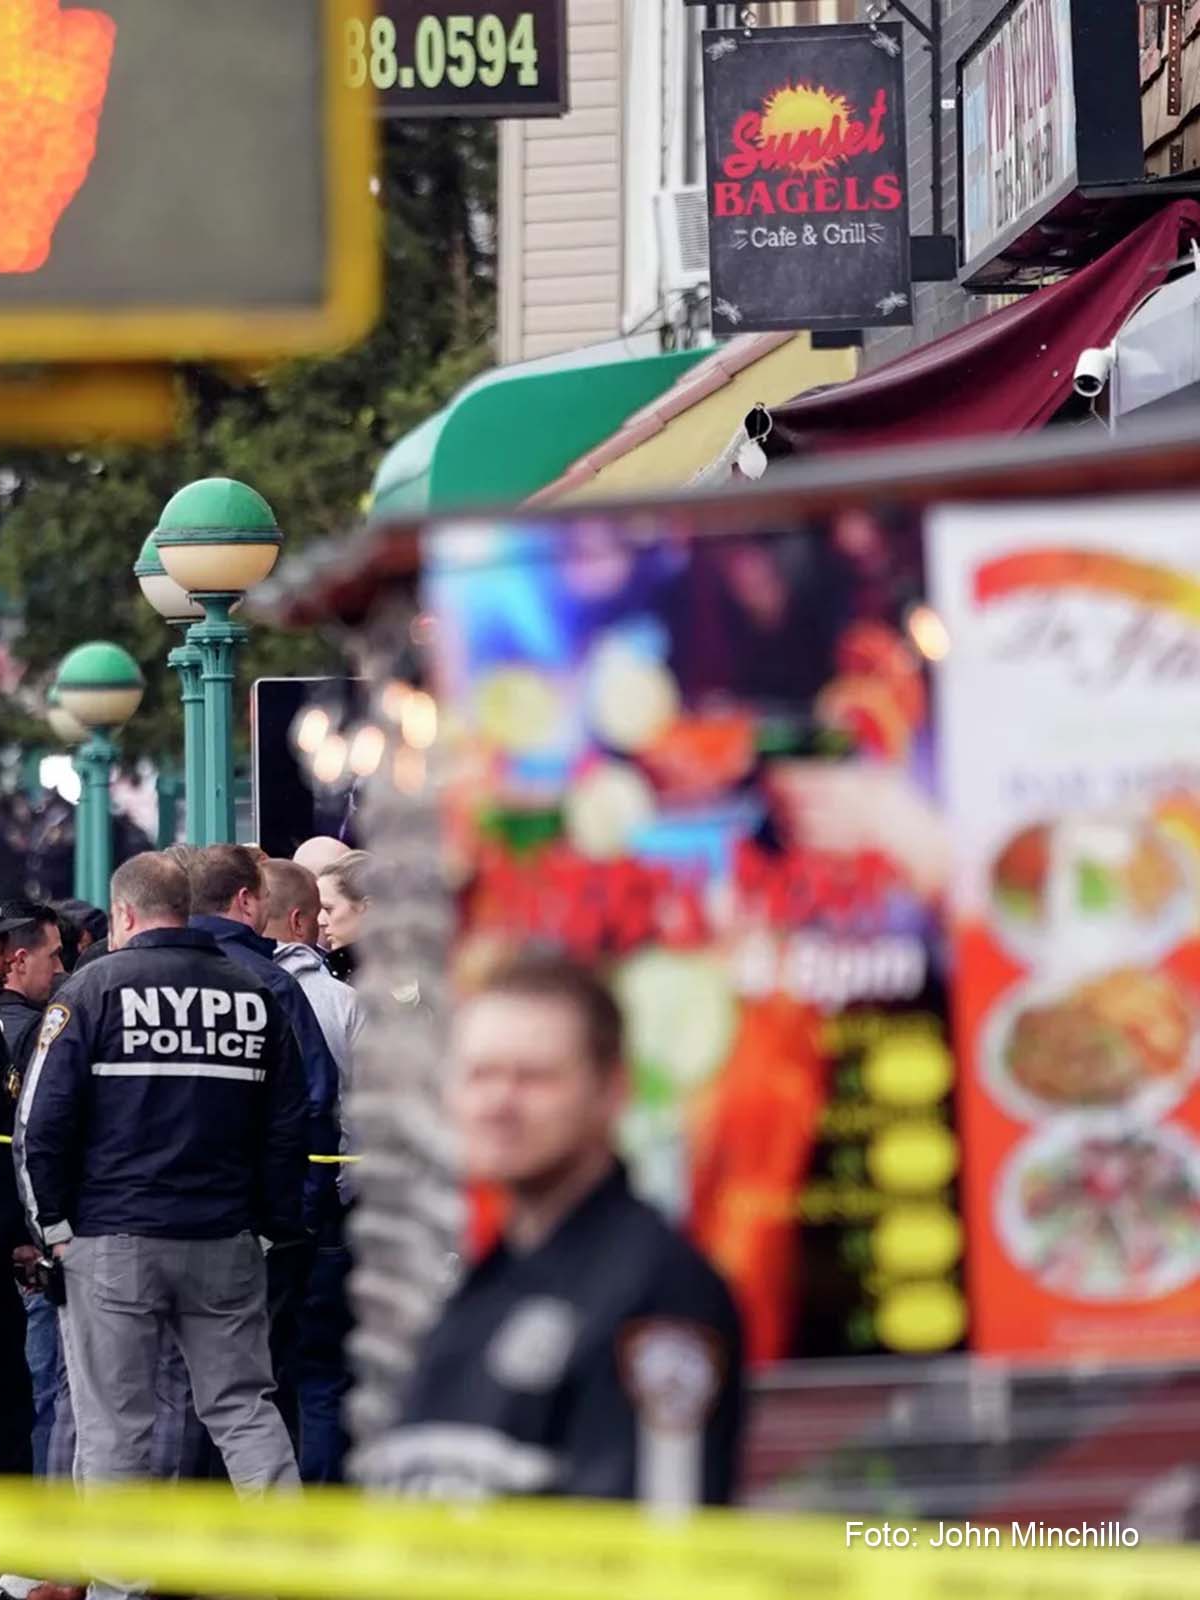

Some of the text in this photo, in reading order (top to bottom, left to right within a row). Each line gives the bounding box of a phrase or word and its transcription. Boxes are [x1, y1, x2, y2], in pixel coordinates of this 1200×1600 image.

[723, 88, 887, 180] Sunset
[713, 173, 903, 218] BAGELS
[751, 222, 867, 248] Cafe & Grill
[120, 986, 268, 1032] NYPD
[123, 1029, 266, 1059] POLICE
